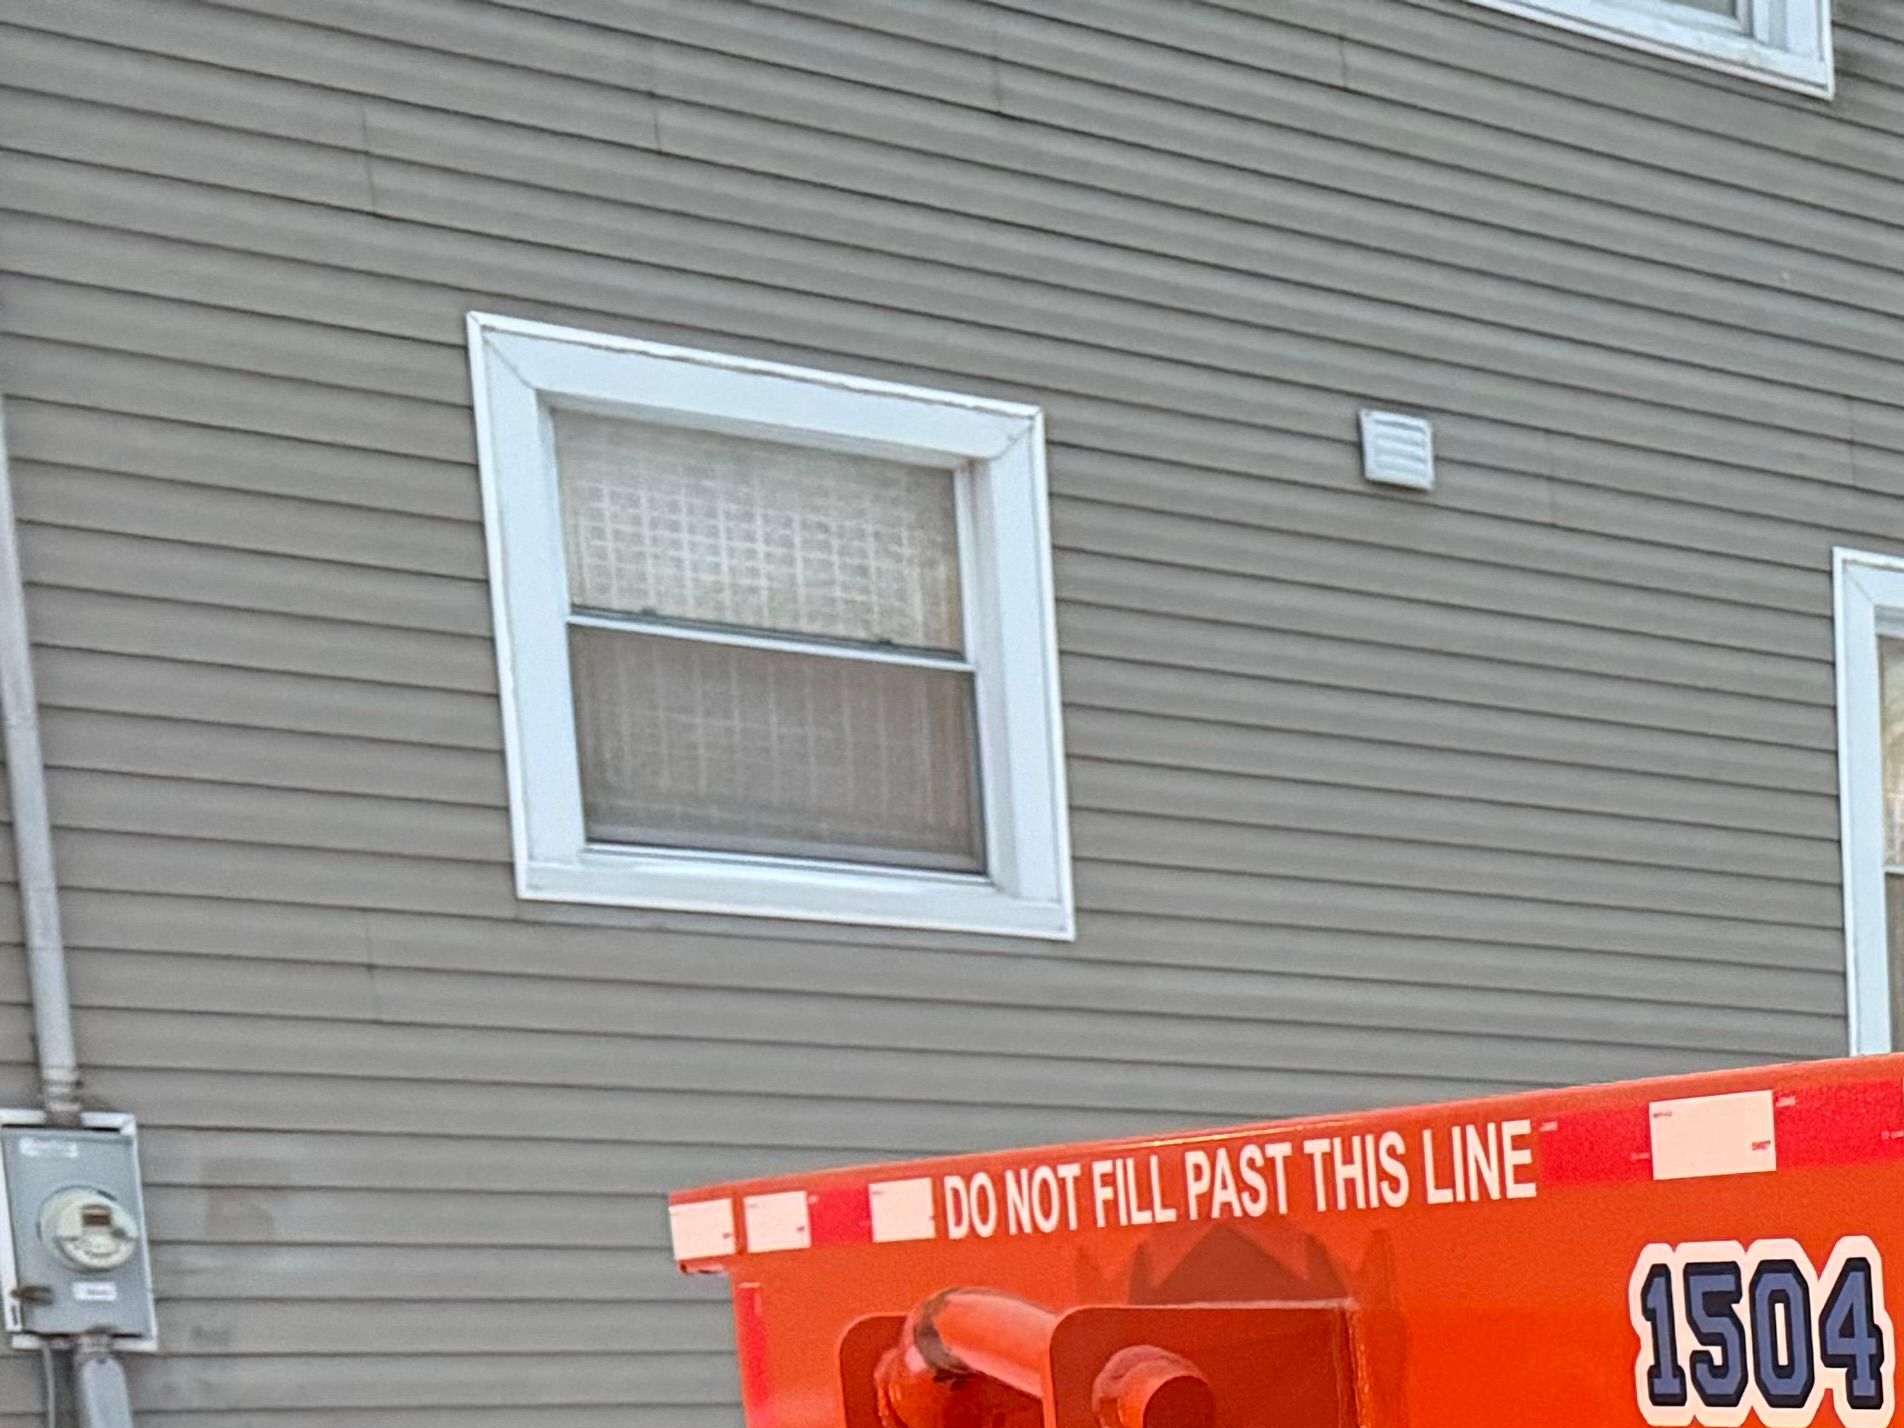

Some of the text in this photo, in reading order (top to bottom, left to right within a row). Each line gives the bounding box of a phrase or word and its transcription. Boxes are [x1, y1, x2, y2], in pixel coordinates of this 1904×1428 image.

[944, 1119, 1537, 1240] DO NOT FILL PAST THIS LINE
[1637, 1254, 1886, 1412] 1504
